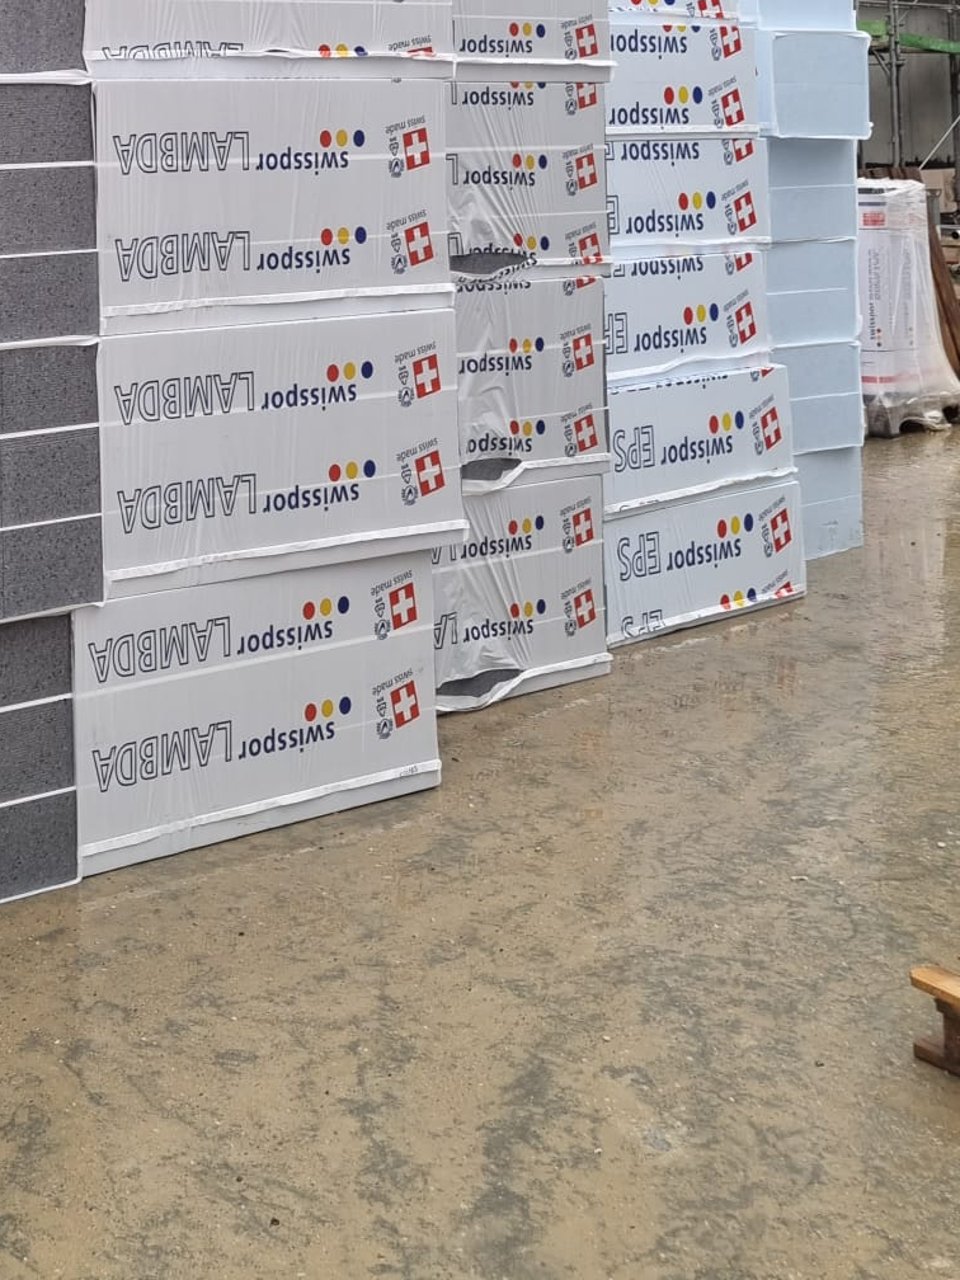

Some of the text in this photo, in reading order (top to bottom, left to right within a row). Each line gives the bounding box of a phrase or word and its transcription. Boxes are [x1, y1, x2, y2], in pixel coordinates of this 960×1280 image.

[387, 41, 409, 51] made
[460, 34, 533, 58] swisspor
[462, 86, 535, 111] swisspor
[385, 115, 426, 135] swiss made
[609, 102, 690, 130] swisspor
[112, 131, 349, 176] swisspor LAMBDA
[621, 140, 700, 166] swisspor
[463, 166, 536, 191] swisspor
[386, 208, 428, 231] swiss made
[626, 209, 704, 238] swisspor
[115, 230, 351, 282] swisspor LAMBDA
[634, 324, 707, 353] swisspor
[394, 340, 437, 364] swiss made
[458, 352, 532, 376] swisspor
[114, 371, 357, 426] swisspor LAMBDA
[396, 437, 438, 462] swiss made
[613, 425, 733, 473] swisspor EPS
[117, 473, 360, 534] swisspor LAMBDA
[461, 535, 533, 559] swisspor
[617, 531, 741, 582] swisspor EPS
[370, 570, 414, 596] swiss made
[463, 618, 535, 644] swisspor
[88, 616, 333, 684] swisspor LAMBDA
[372, 668, 414, 696] swiss made
[92, 720, 336, 792] swisspor LAMBDA
